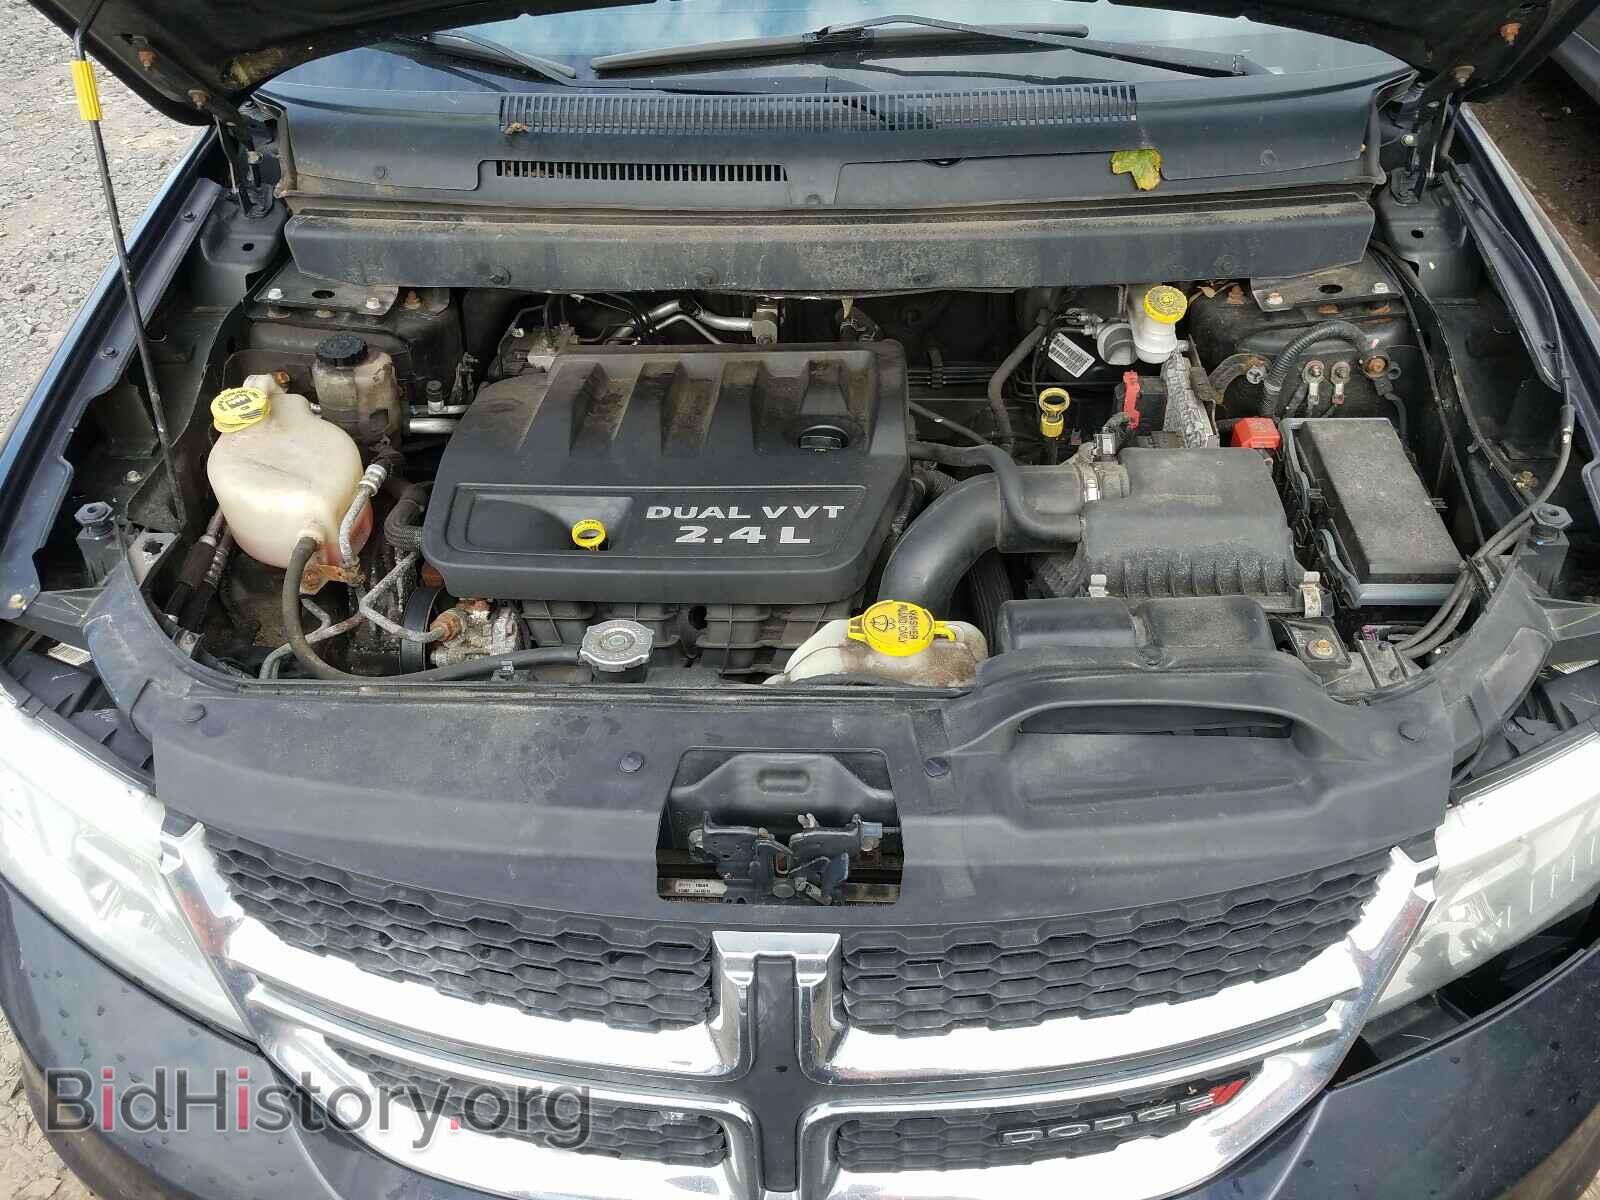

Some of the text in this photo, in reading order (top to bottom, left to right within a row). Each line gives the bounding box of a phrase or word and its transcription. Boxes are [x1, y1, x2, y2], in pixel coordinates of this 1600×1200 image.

[646, 505, 845, 519] DUAL VVT
[1002, 1093, 1215, 1146] DODGE
